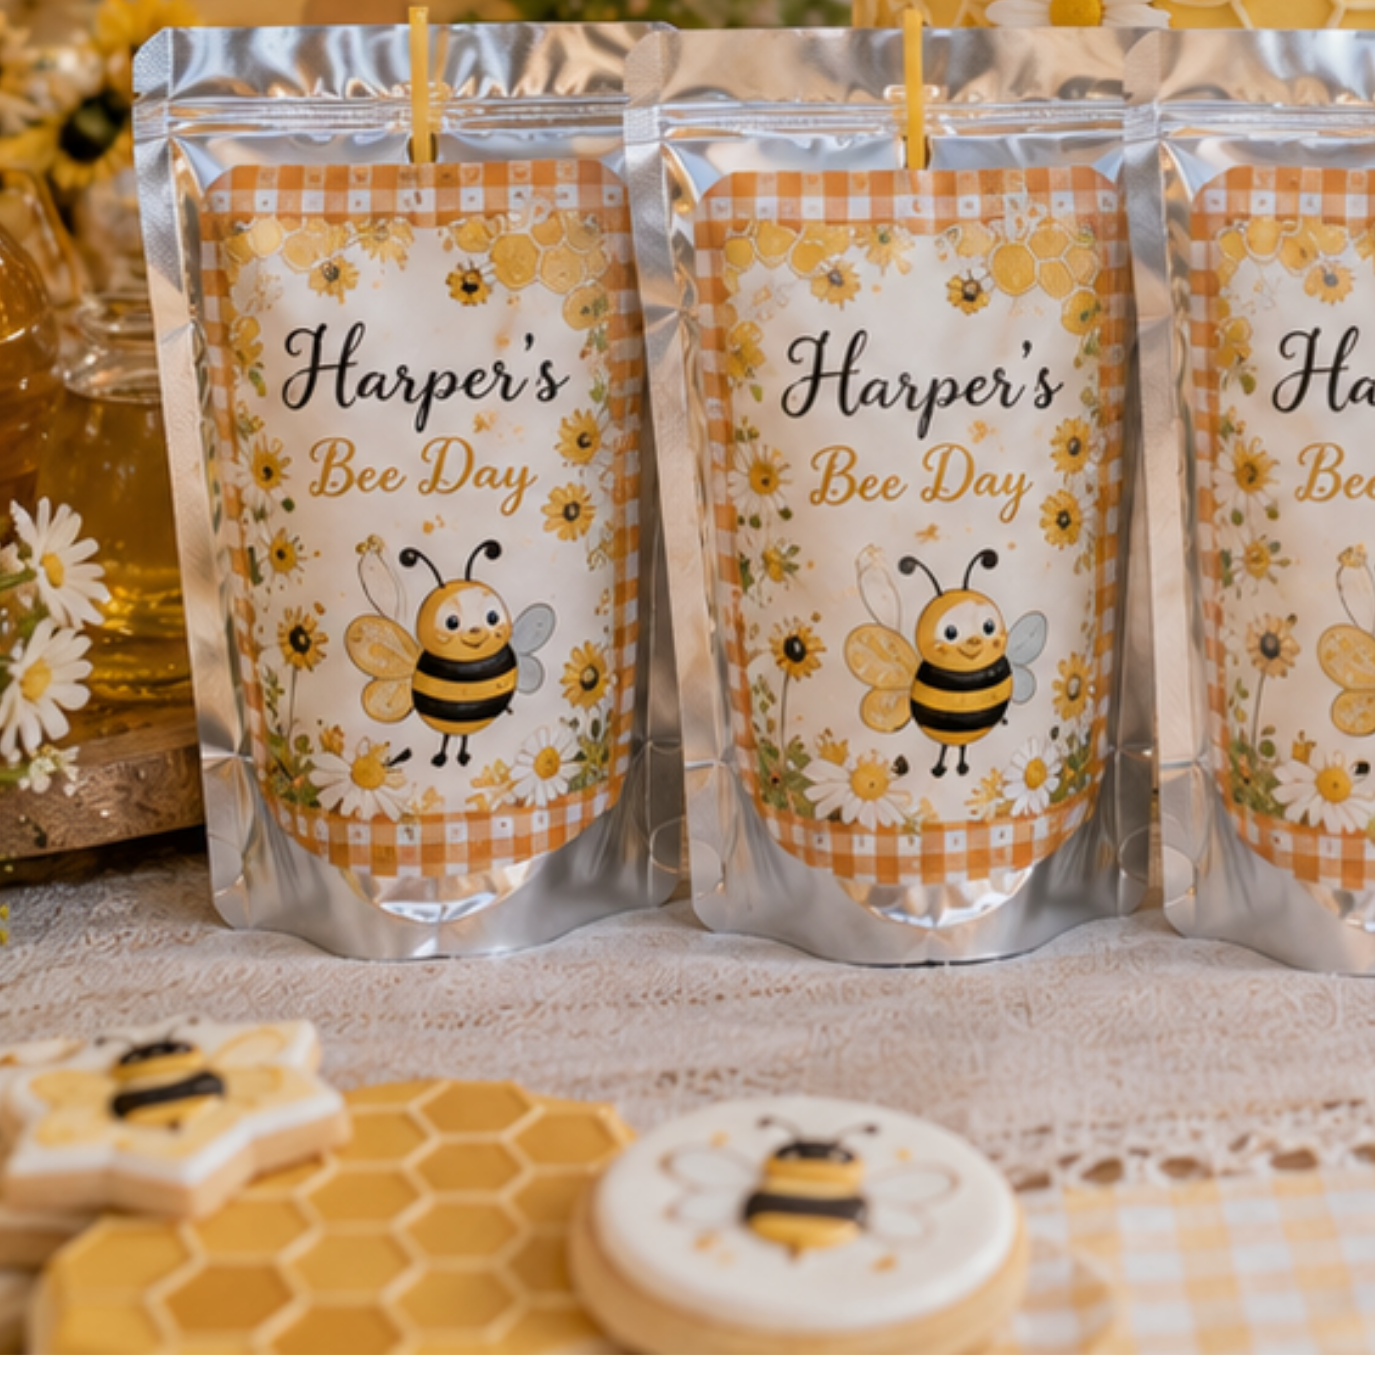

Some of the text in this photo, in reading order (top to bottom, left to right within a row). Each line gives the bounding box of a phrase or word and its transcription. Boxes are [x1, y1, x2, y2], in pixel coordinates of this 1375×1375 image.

[280, 321, 572, 434] Harper's
[779, 329, 1065, 440] Harper's
[307, 435, 538, 518] Bee Day
[807, 442, 1036, 525] Bee Day
